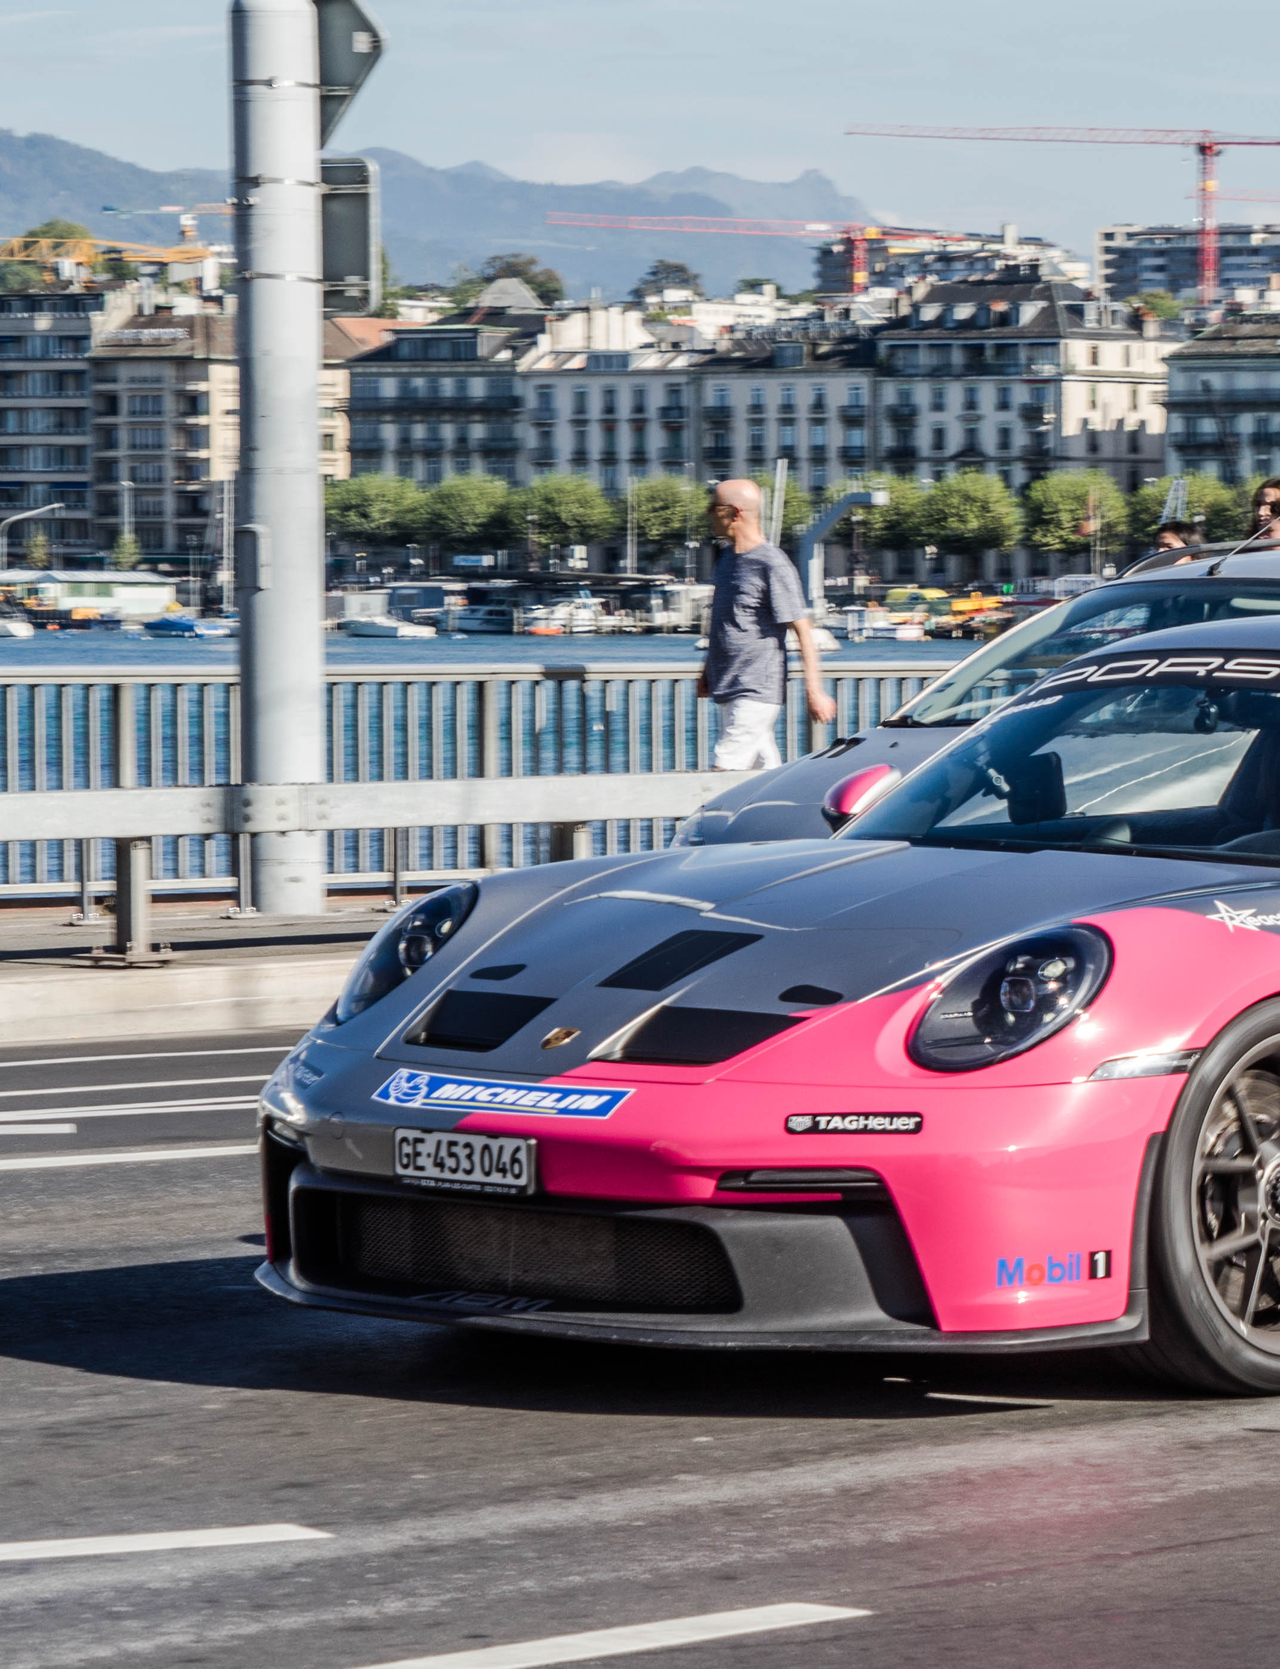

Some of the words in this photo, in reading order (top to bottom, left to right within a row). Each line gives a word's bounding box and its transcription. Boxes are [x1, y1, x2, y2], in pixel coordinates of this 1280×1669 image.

[429, 1083, 613, 1110] MICHELIN
[996, 1252, 1081, 1287] Mobil
[1093, 1251, 1106, 1279] 1
